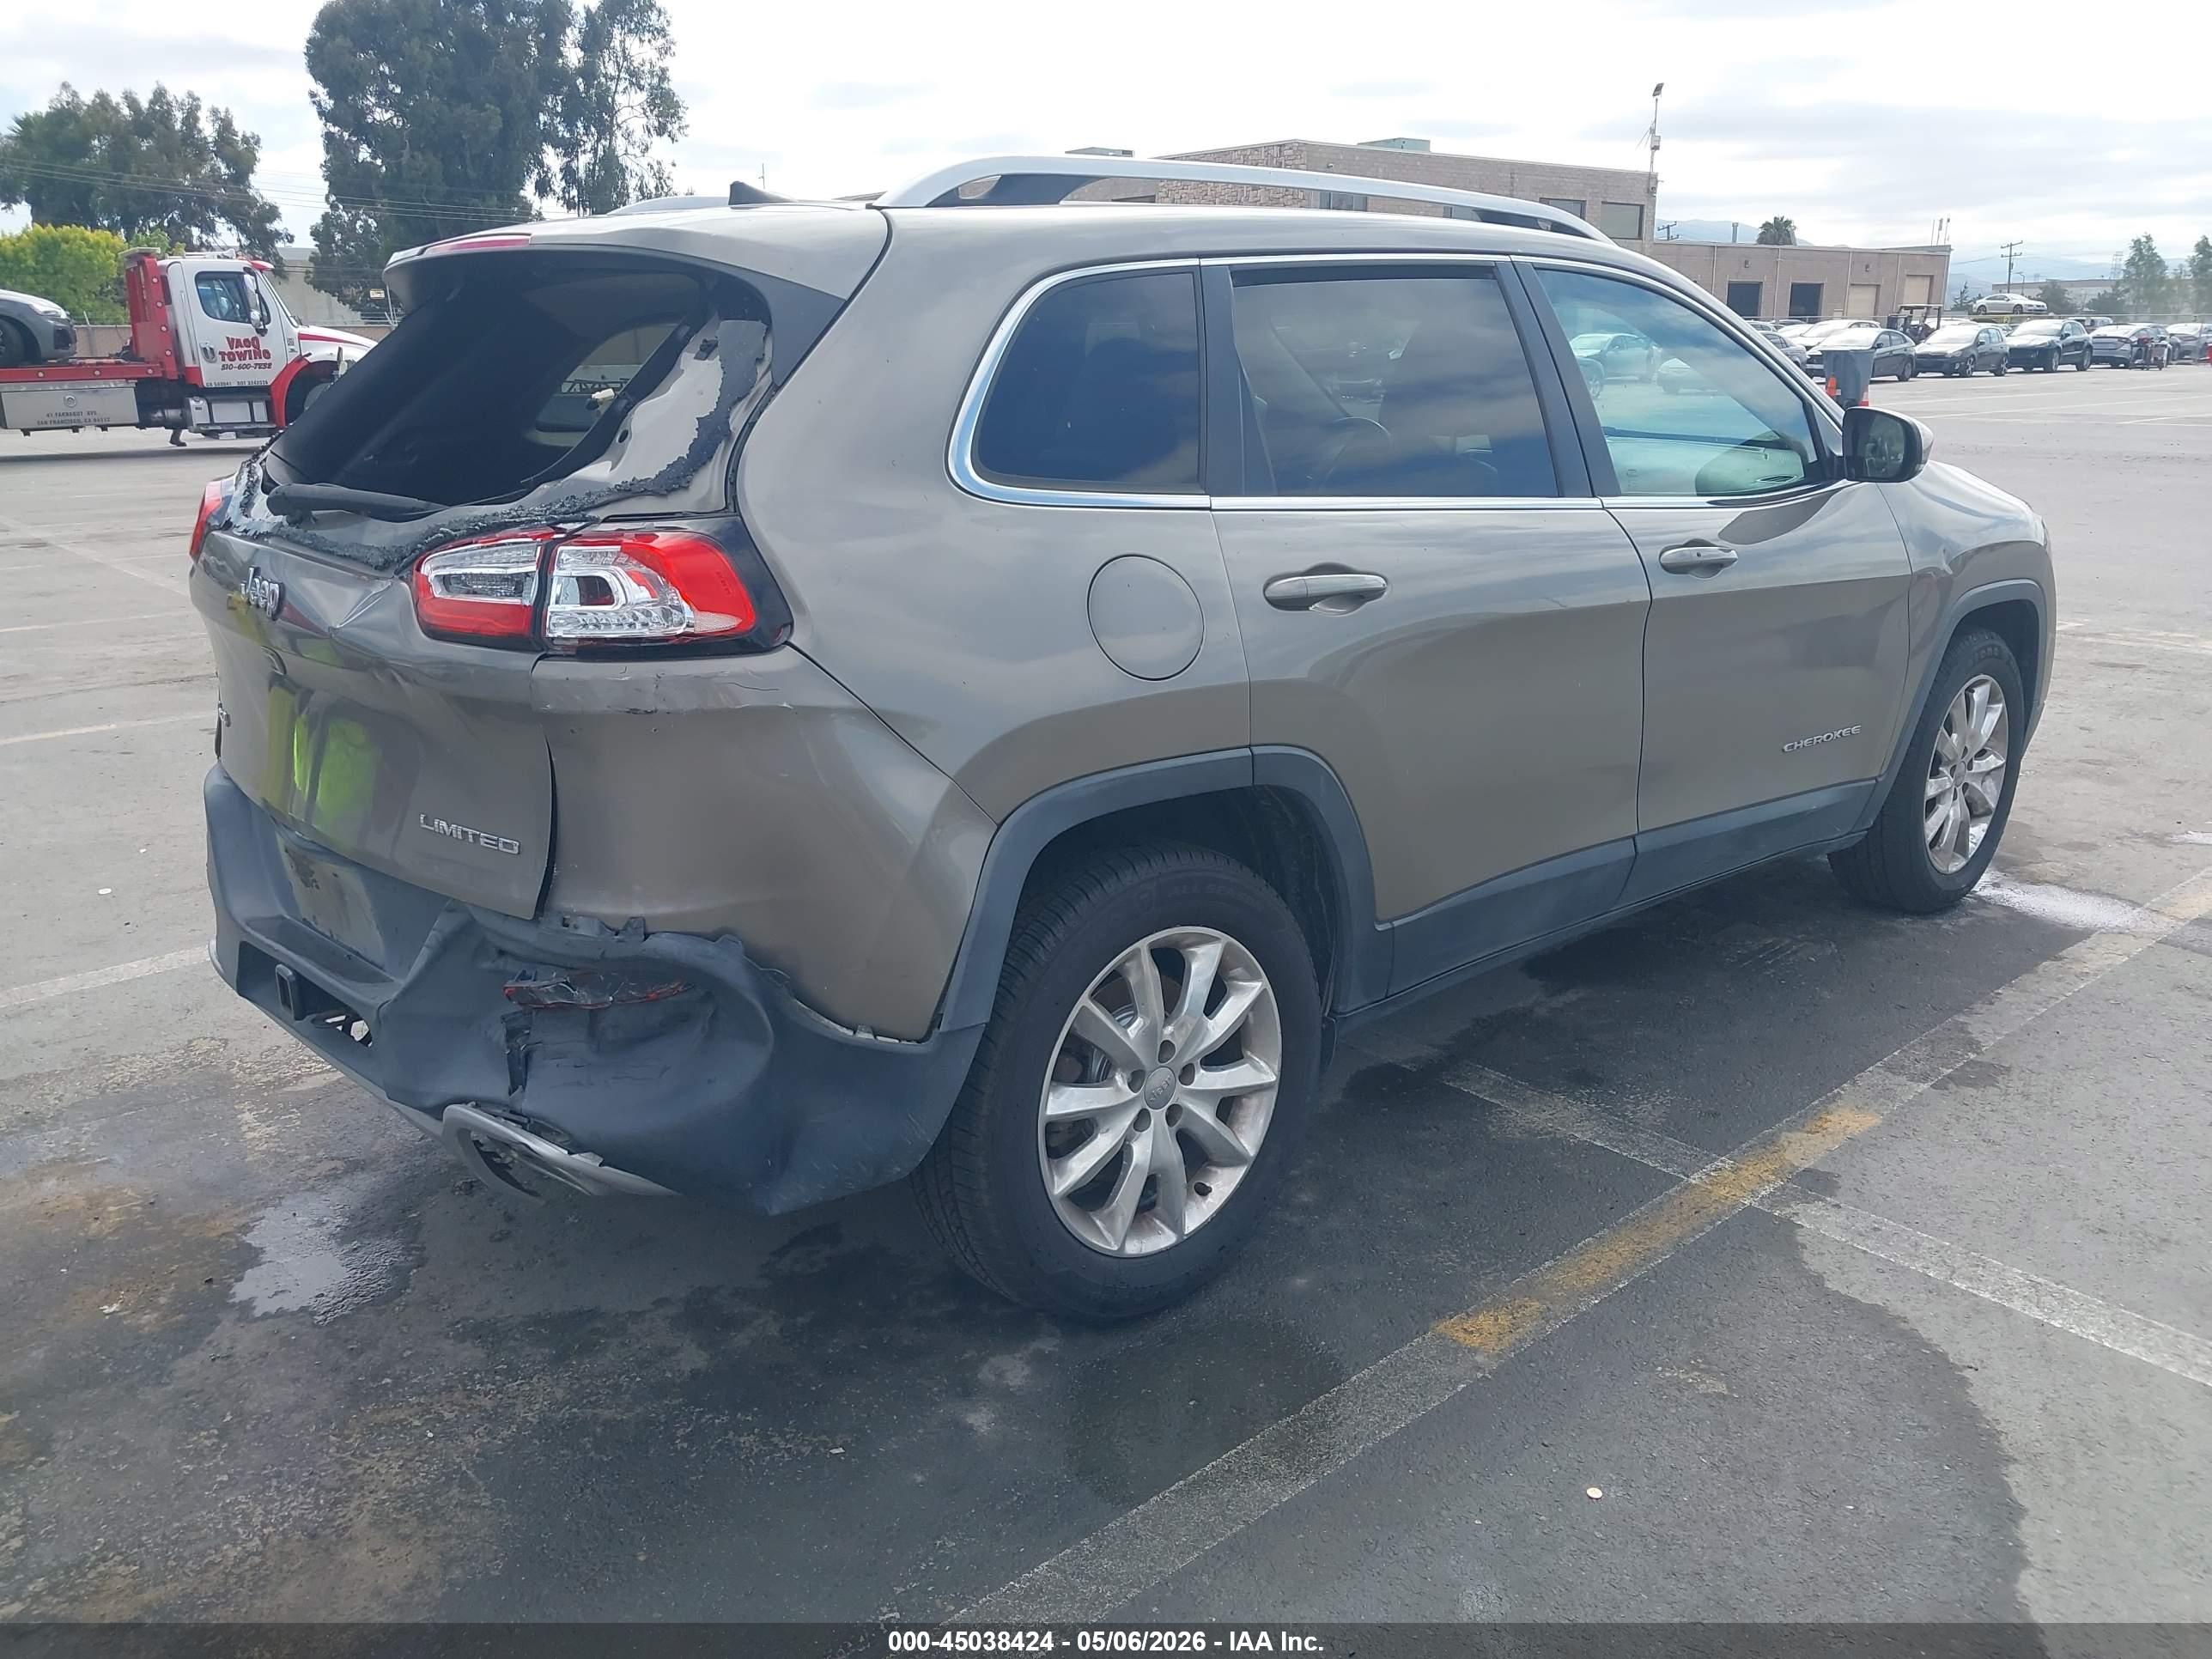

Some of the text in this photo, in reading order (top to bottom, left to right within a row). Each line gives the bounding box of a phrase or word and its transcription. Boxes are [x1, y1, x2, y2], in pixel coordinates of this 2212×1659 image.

[218, 349, 271, 362] TOWING
[240, 566, 283, 618] Jeep
[1783, 724, 1862, 752] CHEROKEE
[419, 813, 520, 854] LIMITED
